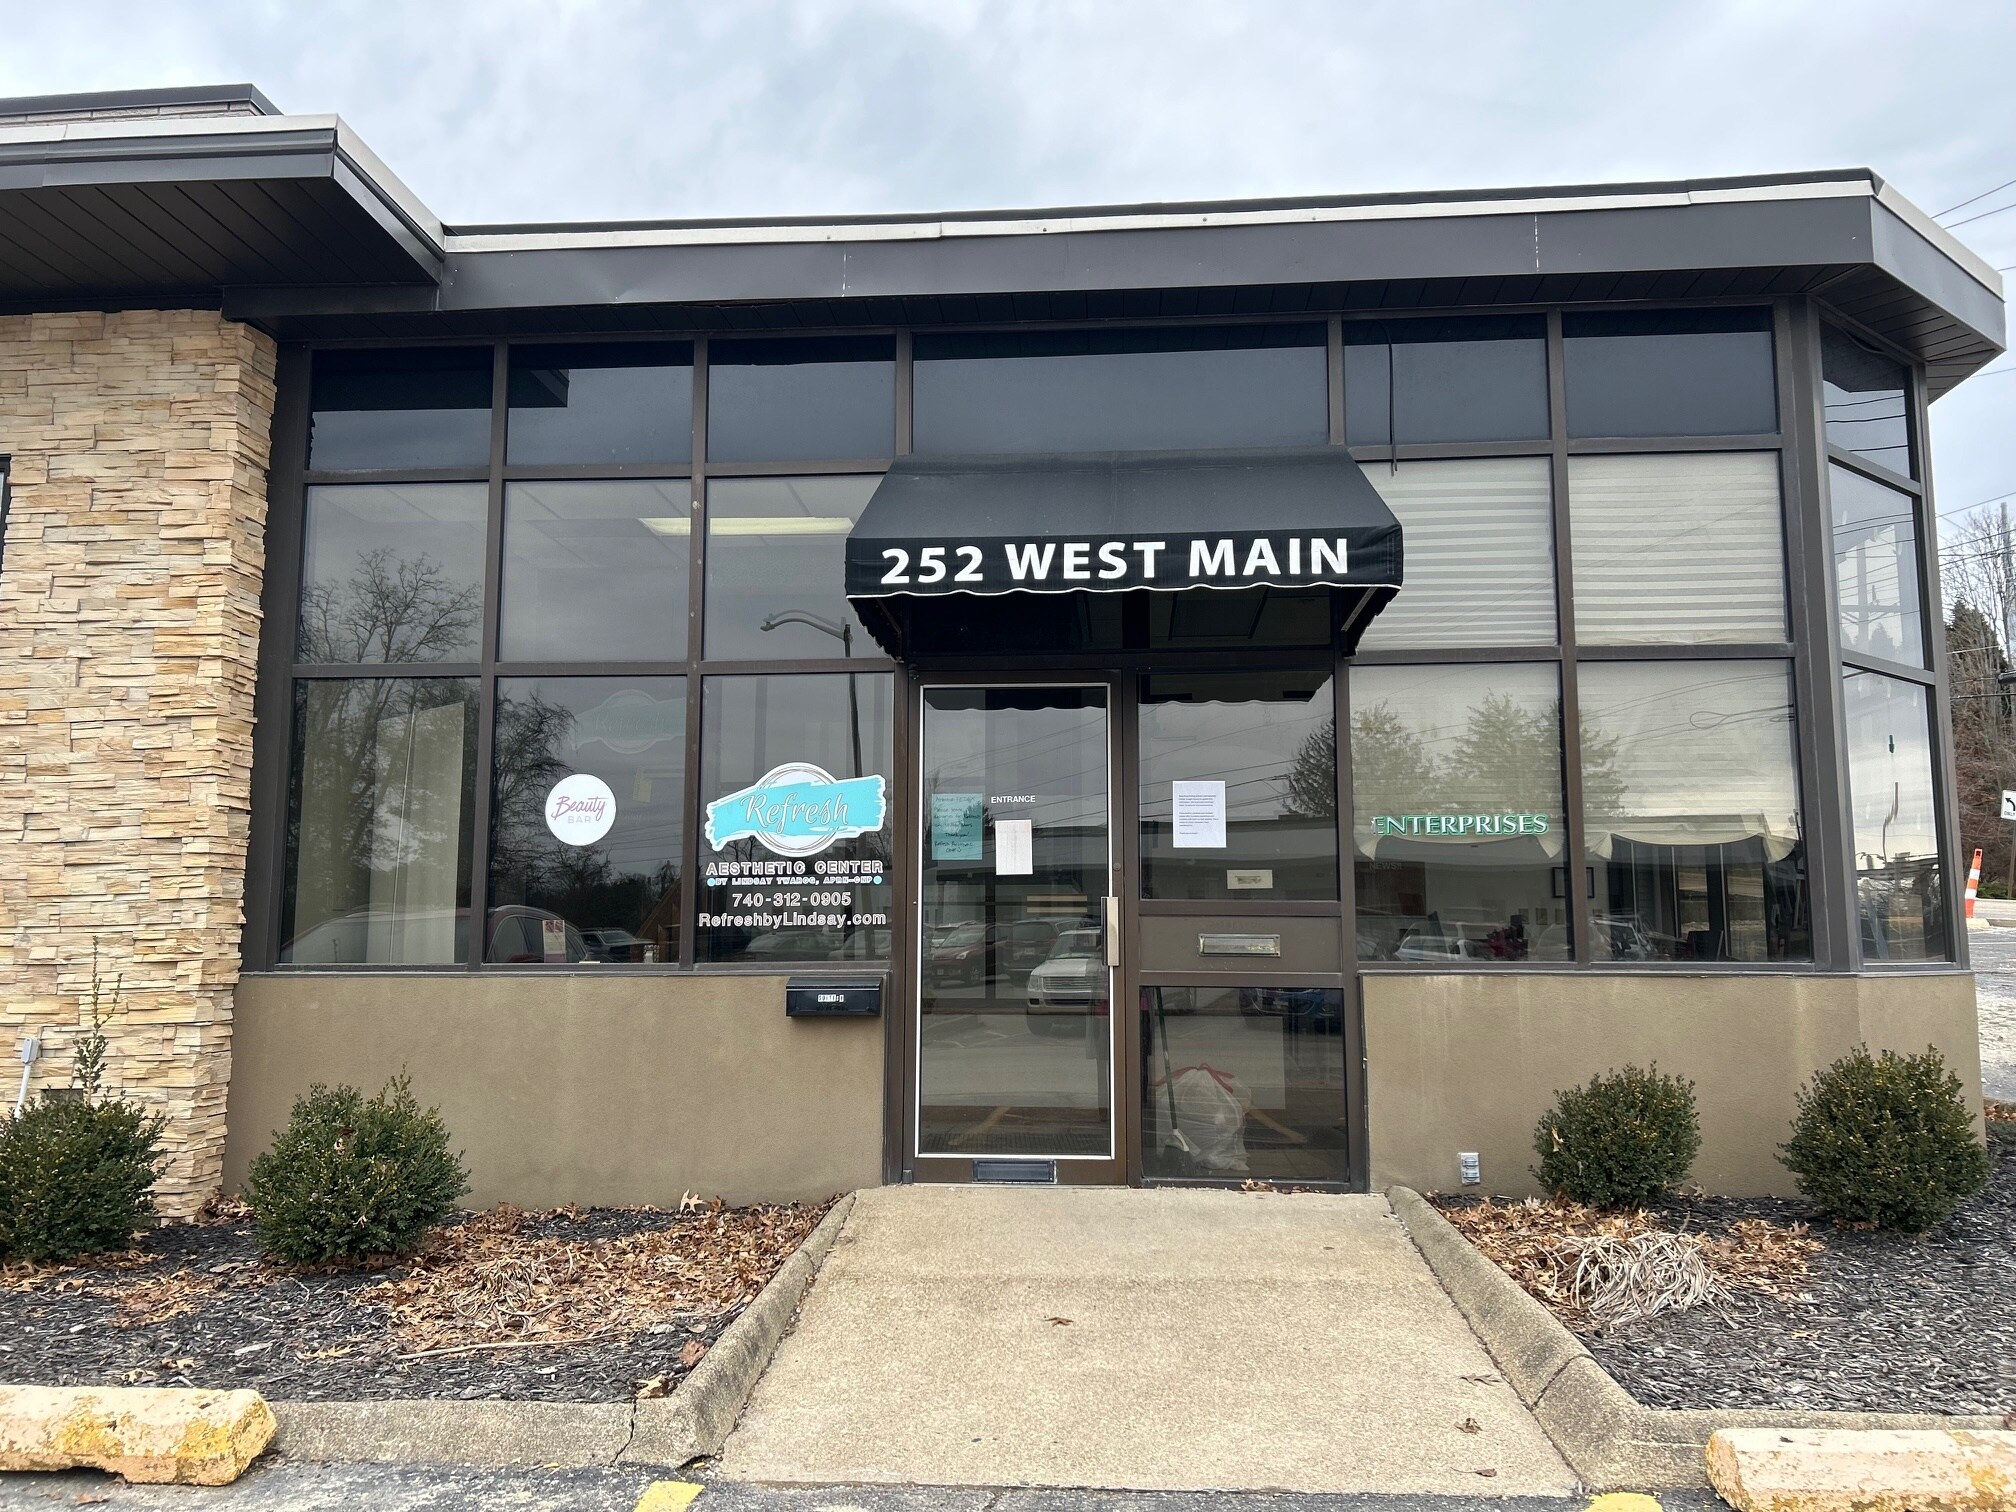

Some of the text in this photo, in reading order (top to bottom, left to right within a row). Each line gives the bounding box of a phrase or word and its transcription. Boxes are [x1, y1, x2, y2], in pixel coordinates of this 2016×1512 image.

[881, 537, 1348, 585] 252 WEST MAIN
[991, 795, 1036, 804] ENTRANCE
[551, 796, 609, 821] Beauty
[740, 792, 848, 833] Refresh
[567, 815, 592, 824] BAR
[1371, 814, 1549, 835] ENTERPRISES
[706, 860, 884, 876] AESTHETIC CENTER
[715, 877, 728, 886] BY
[732, 876, 773, 886] LINDSAY
[732, 892, 851, 907] 740-312-0905
[698, 912, 887, 929] RefreshbyLindsay.com
